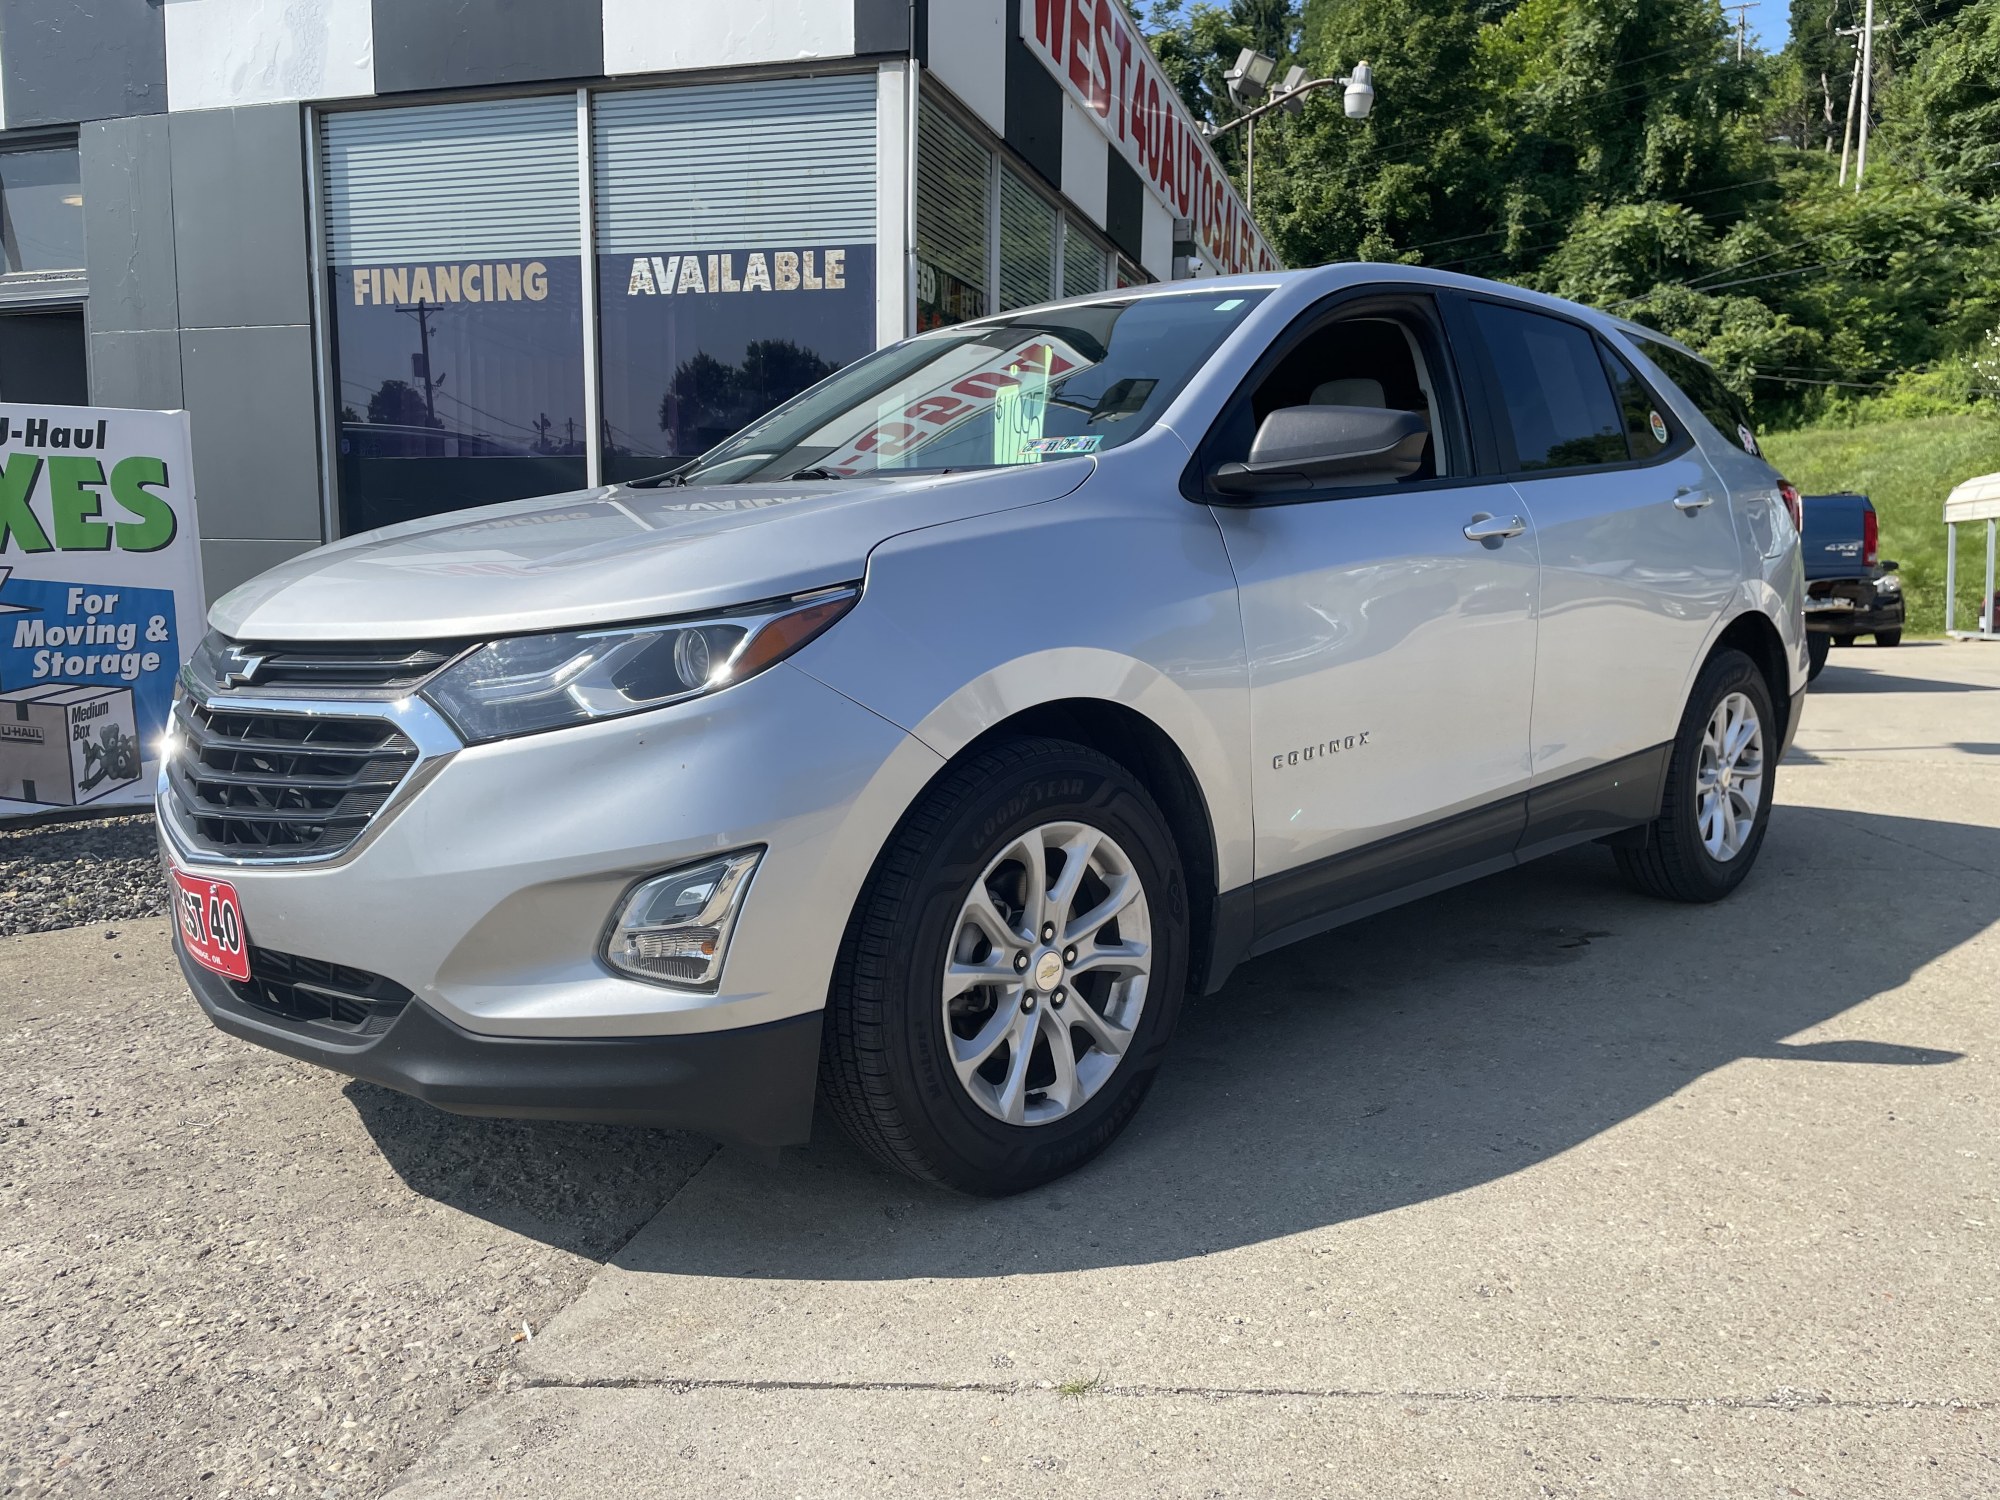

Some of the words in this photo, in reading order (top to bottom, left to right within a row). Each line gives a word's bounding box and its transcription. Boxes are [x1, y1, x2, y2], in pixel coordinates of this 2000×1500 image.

[1034, 0, 1131, 142] WEST
[1131, 59, 1161, 182] 40
[1160, 101, 1213, 248] AUTO
[354, 262, 548, 306] FINANCING
[628, 249, 847, 295] AVAILABLE
[67, 588, 119, 615] For
[13, 616, 138, 650] Moving
[145, 615, 169, 642] &
[32, 650, 160, 681] Storage
[71, 701, 109, 725] Medium
[1, 726, 42, 739] U-HAUL
[73, 724, 90, 741] Box
[1273, 731, 1370, 770] EQUINOX
[209, 896, 241, 955] 40
